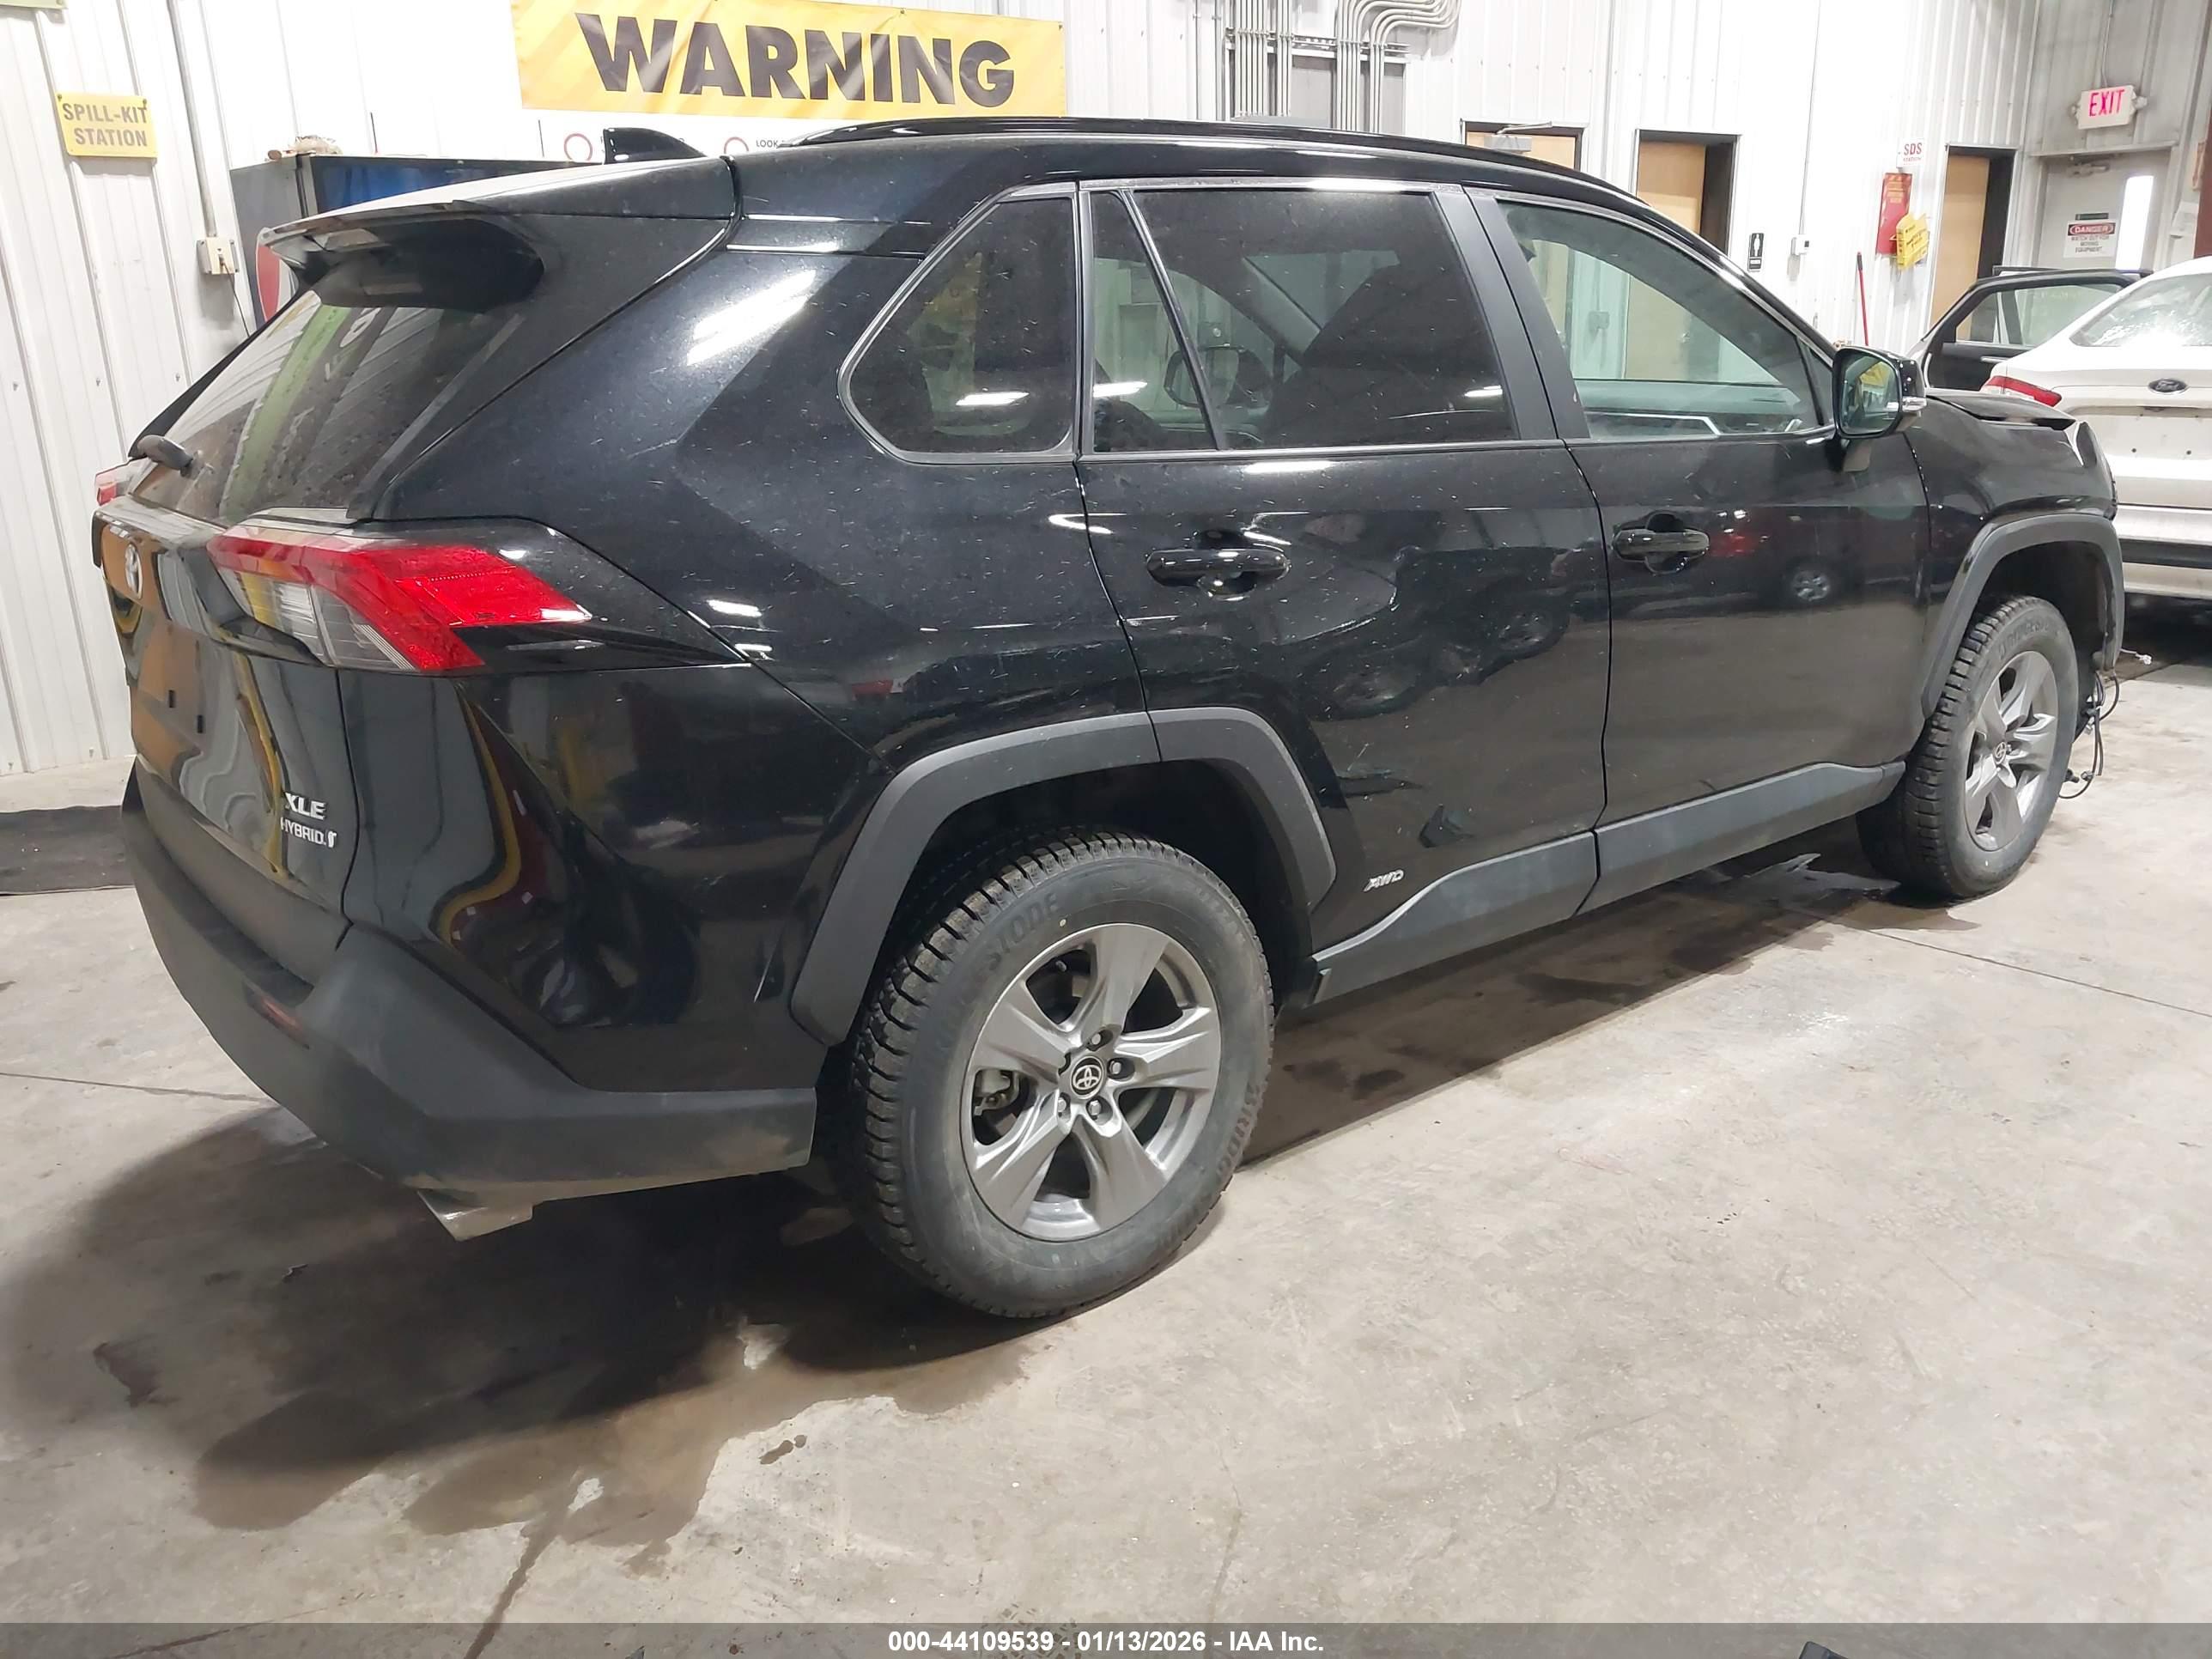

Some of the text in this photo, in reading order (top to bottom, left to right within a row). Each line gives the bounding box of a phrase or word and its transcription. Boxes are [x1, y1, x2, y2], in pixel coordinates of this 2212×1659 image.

[575, 13, 1014, 107] WARNING
[62, 102, 148, 124] SPILL-KIT
[2088, 88, 2125, 117] EXIT
[74, 128, 148, 147] STATION
[756, 139, 779, 148] LOOK
[1903, 142, 1923, 156] SDS
[284, 792, 326, 821] XLE
[280, 817, 325, 846] HYBRID
